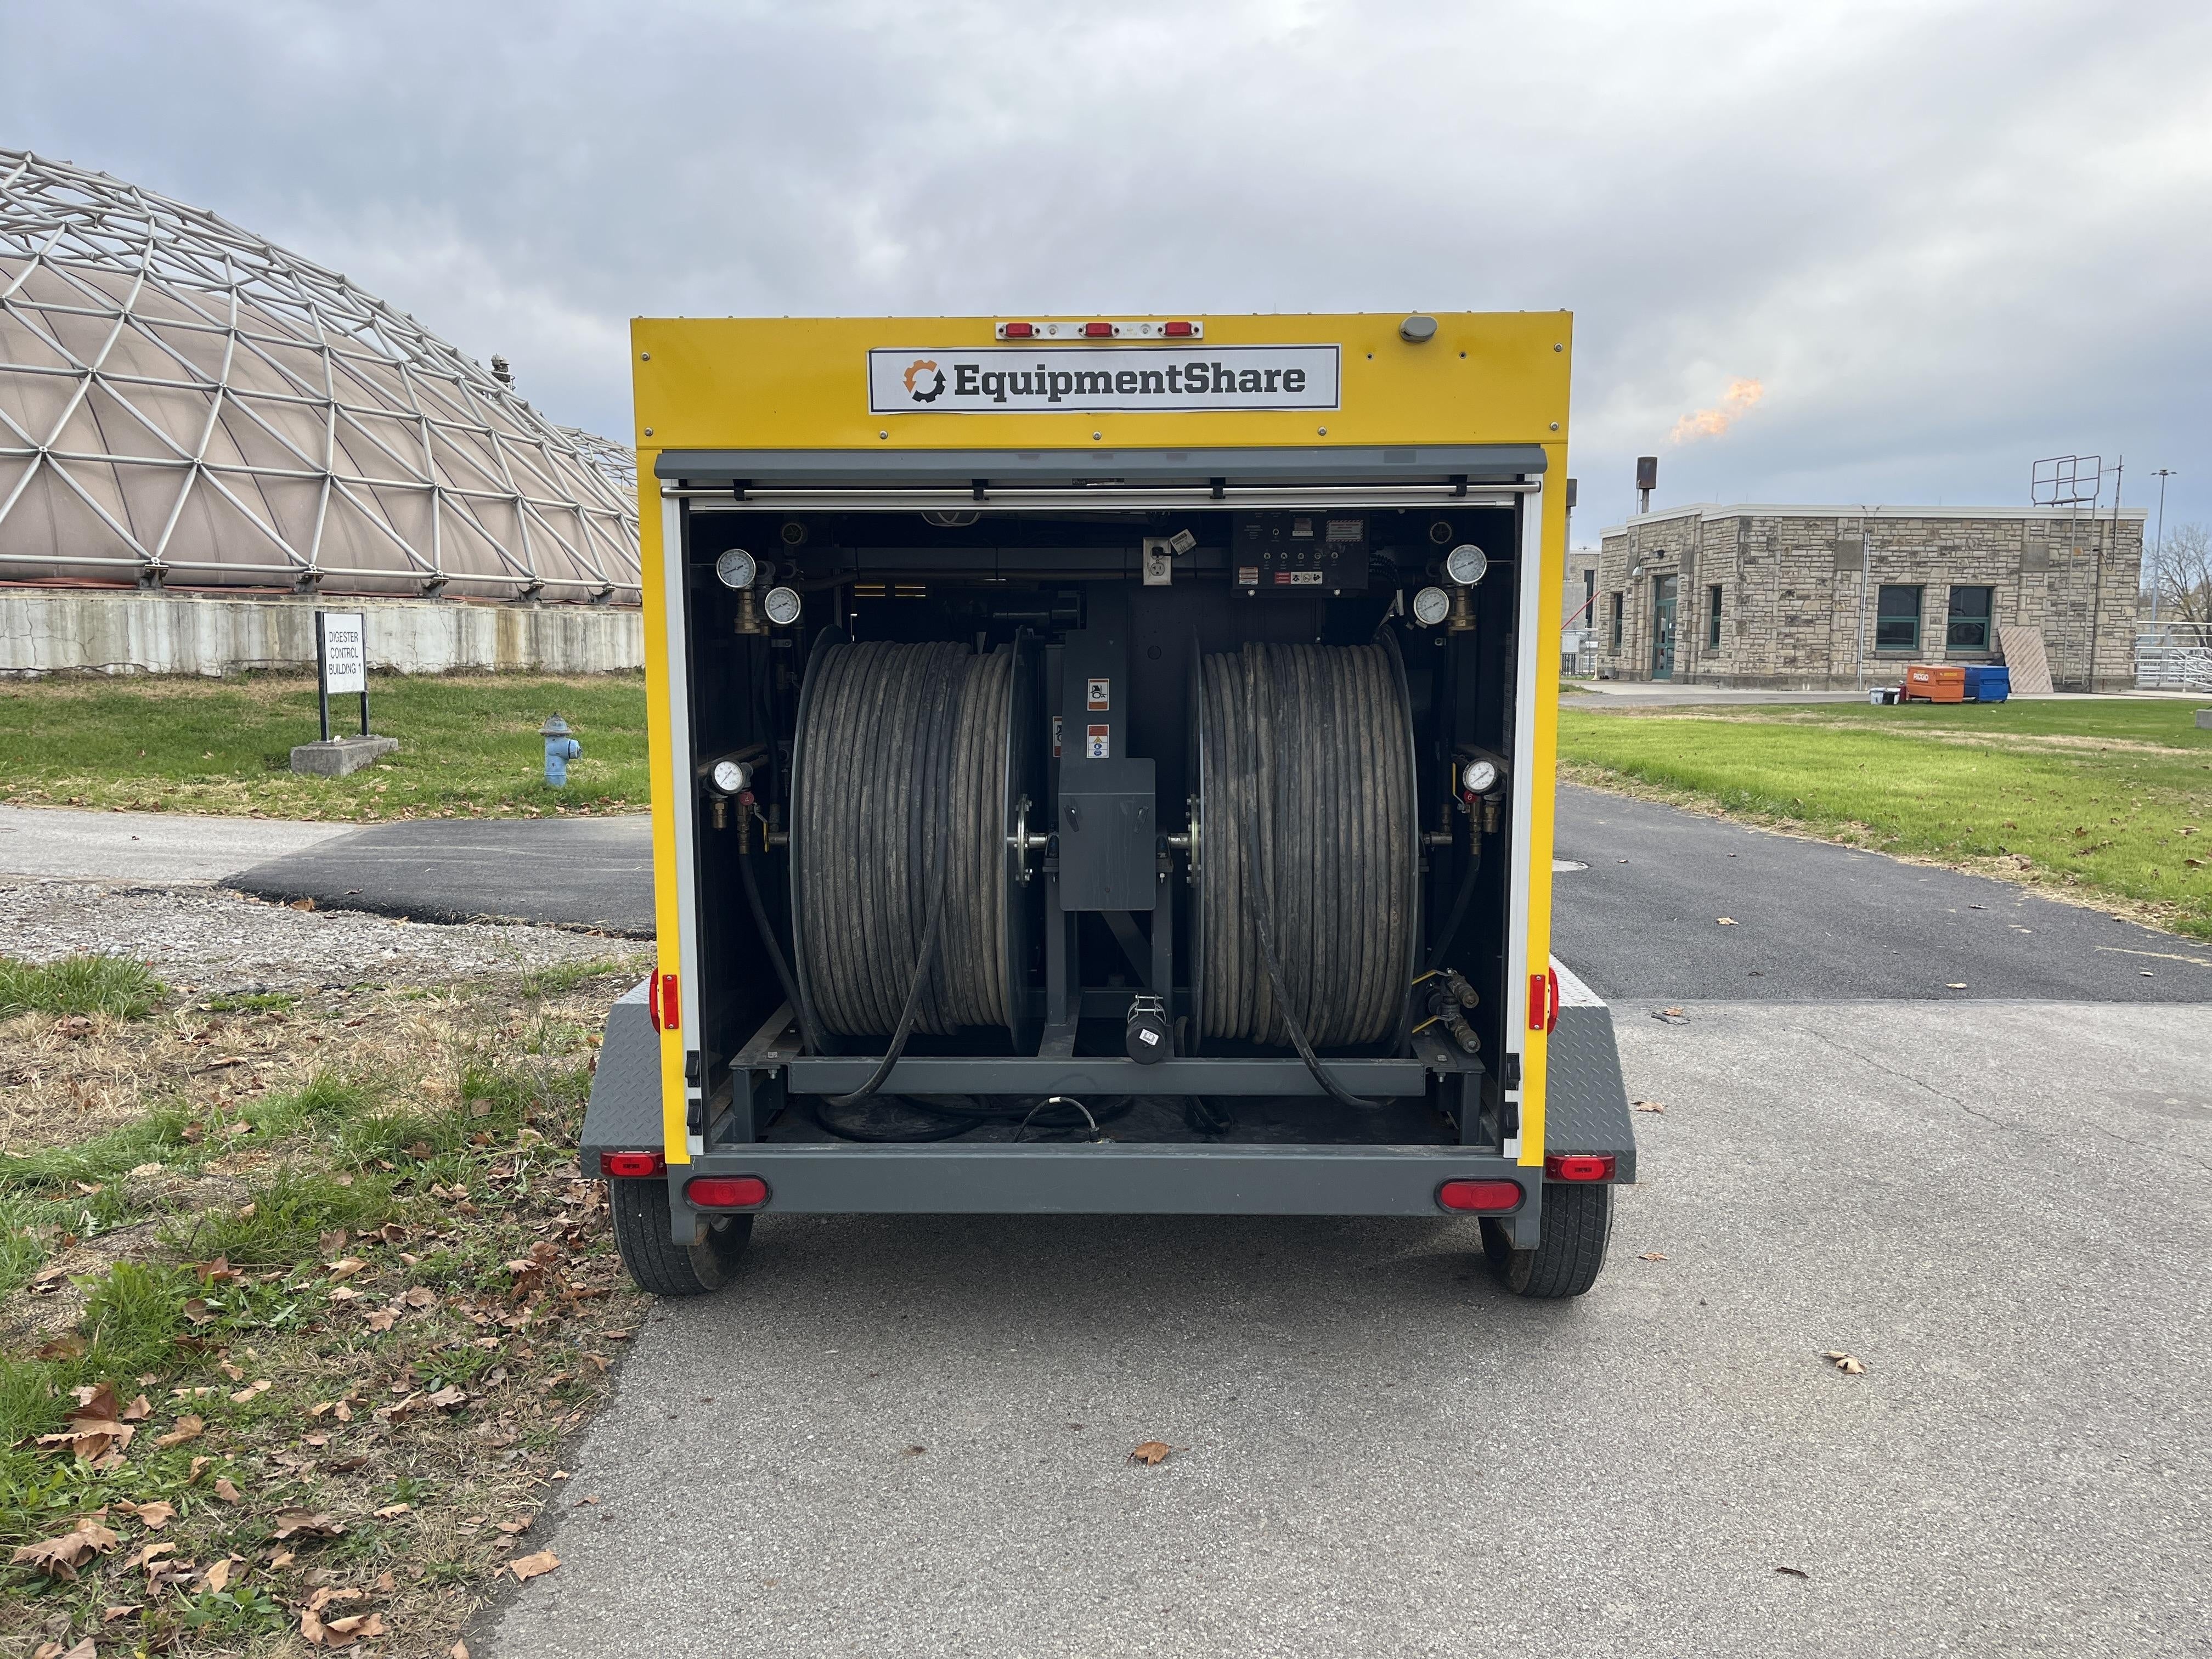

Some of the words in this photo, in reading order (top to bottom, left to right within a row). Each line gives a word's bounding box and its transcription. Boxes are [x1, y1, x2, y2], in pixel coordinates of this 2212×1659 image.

[953, 362, 1305, 402] EquipmentShare
[329, 631, 358, 642] DIGESTER
[331, 647, 358, 658] CONTROL
[329, 663, 356, 675] BUILDING
[358, 663, 362, 674] 1
